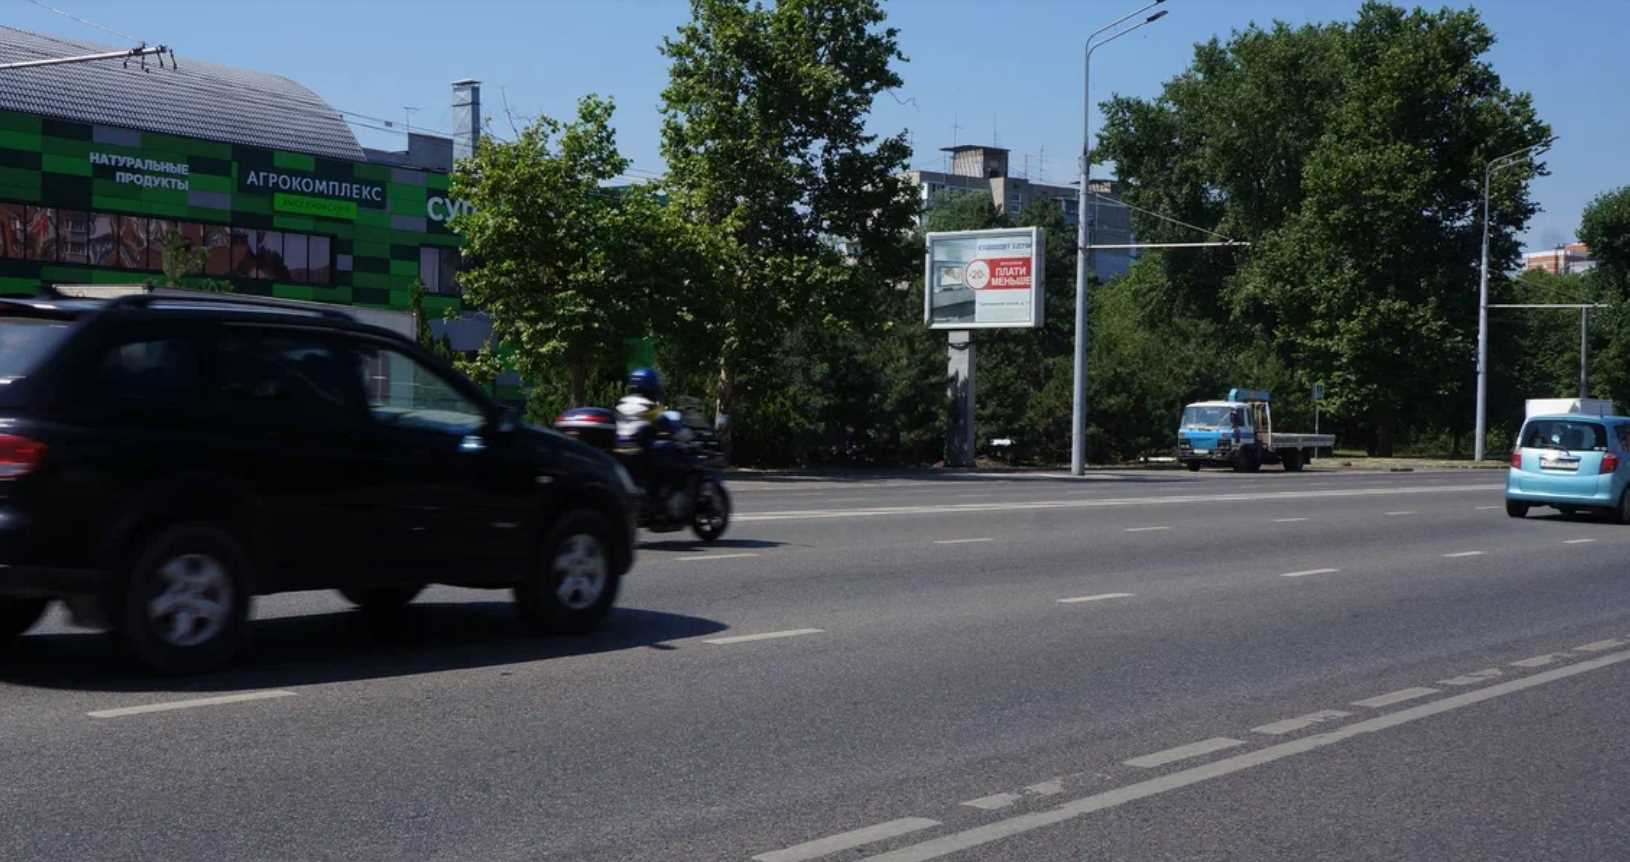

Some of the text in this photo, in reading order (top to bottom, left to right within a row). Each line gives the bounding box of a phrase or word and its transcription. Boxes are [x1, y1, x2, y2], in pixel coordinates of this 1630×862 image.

[89, 152, 190, 175] НАТУРАЛЬНЫЕ
[115, 172, 189, 191] ПРОДУКТЫ
[247, 170, 382, 201] АГРОКОМПЛЕКС
[991, 276, 1032, 286] МЕНЬШЕ
[995, 267, 1027, 276] ПЛАТИ
